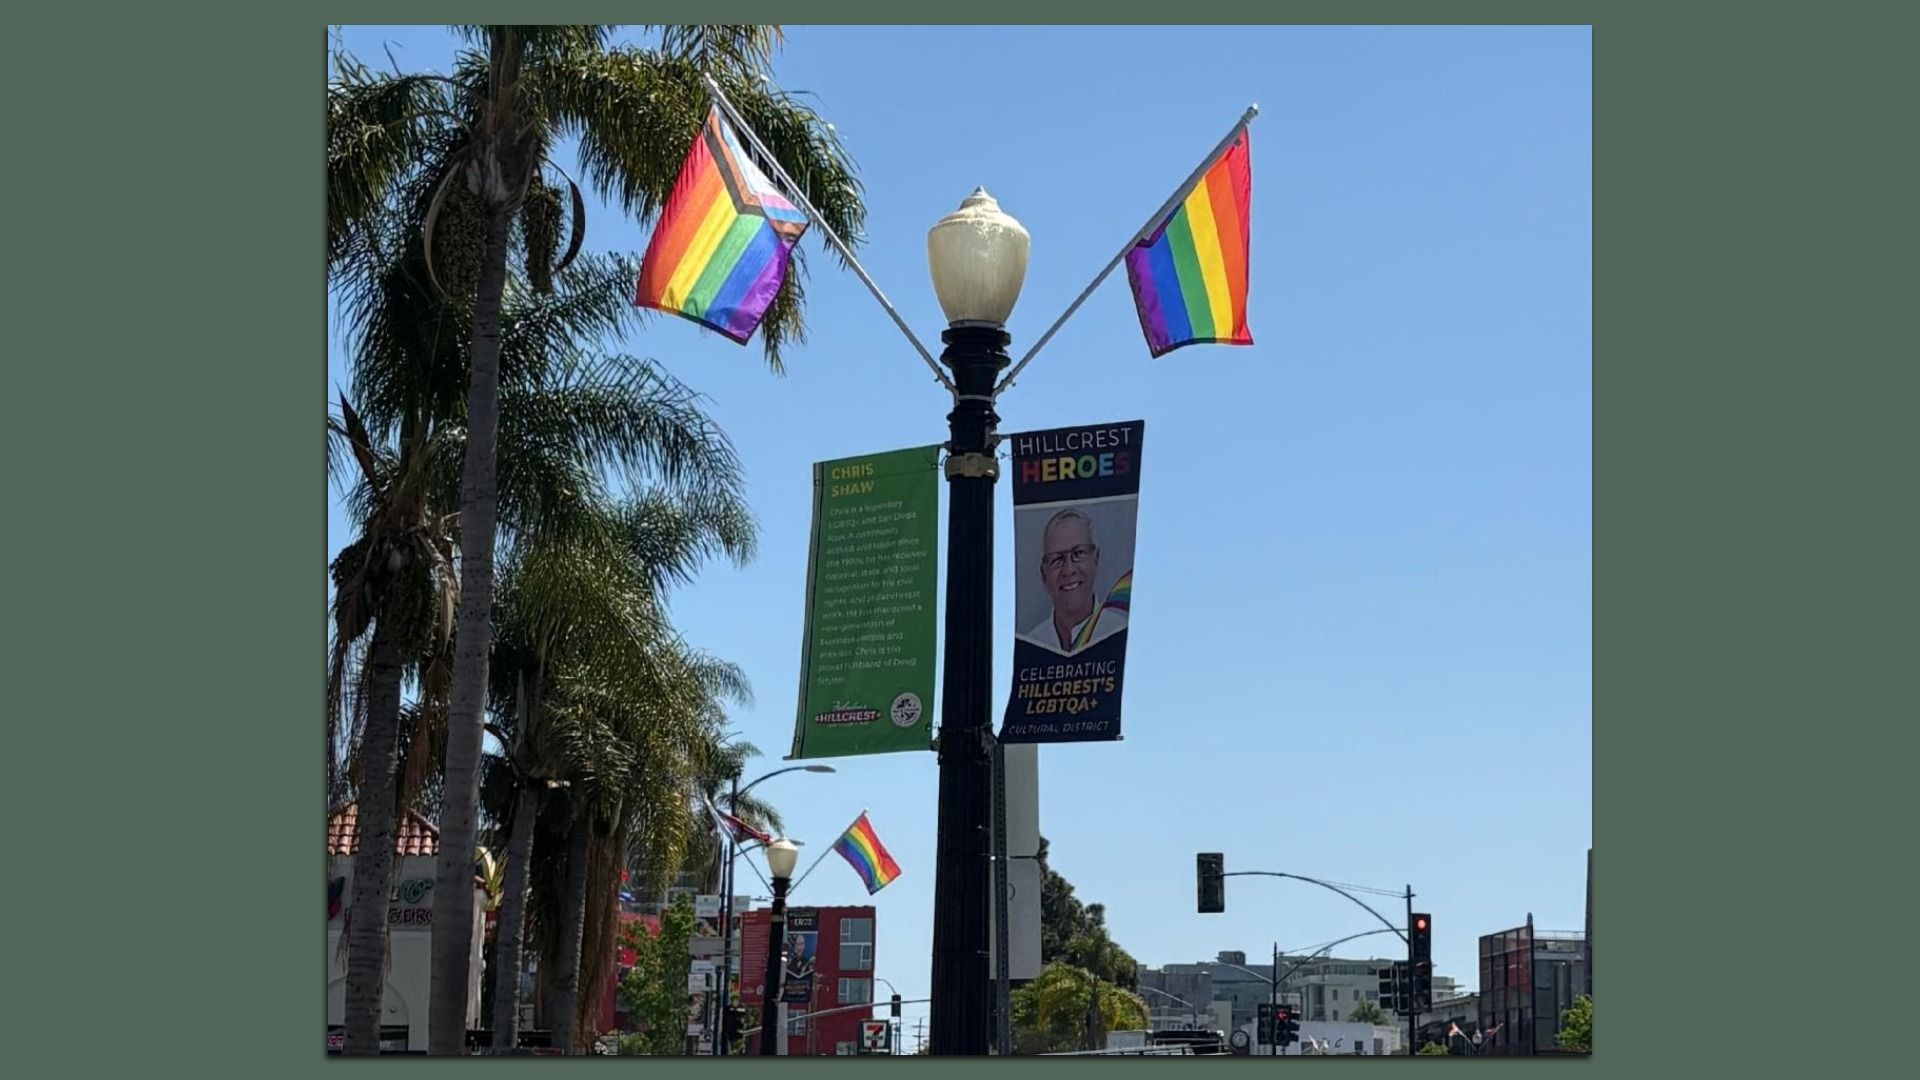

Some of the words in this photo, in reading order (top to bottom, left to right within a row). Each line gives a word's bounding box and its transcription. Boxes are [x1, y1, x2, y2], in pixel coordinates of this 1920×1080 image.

[1019, 427, 1132, 456] HILLCREST
[831, 463, 874, 480] CHRIS
[1021, 452, 1131, 484] HEROES
[831, 480, 875, 497] SHAW
[1020, 660, 1116, 681] CELEBRATING
[1018, 677, 1115, 699] HILLCREST'S
[1025, 696, 1098, 714] LGBTQA+
[819, 711, 876, 722] HILLCREST
[1008, 724, 1059, 735] CULTURAL
[1062, 720, 1109, 733] DISTRICT
